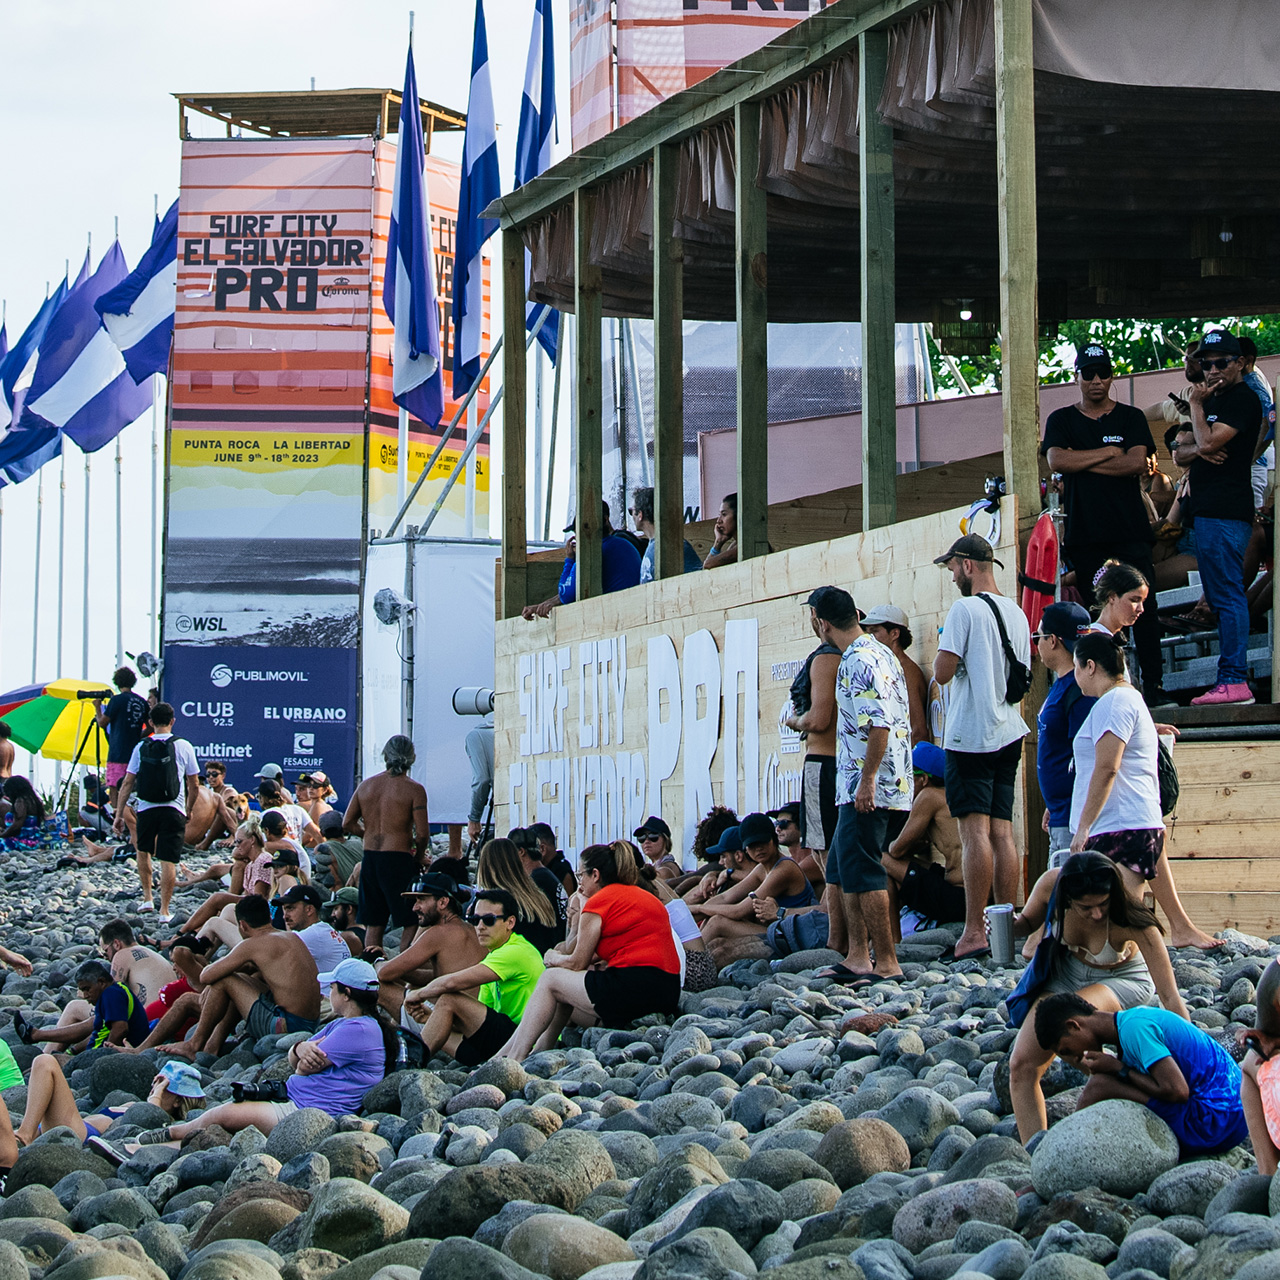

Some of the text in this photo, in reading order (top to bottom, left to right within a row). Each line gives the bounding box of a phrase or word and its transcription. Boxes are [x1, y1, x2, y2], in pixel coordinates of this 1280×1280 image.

[210, 215, 337, 238] SURF CITY
[184, 239, 218, 266] EL
[214, 267, 319, 311] PRO
[321, 285, 360, 298] Corona
[184, 440, 351, 450] PUNTA ROCA LA LIBERTAD
[214, 453, 243, 463] JUNE
[248, 453, 262, 463] 9th
[271, 453, 290, 463] 18th
[292, 453, 319, 463] 2023
[193, 617, 227, 631] WSL
[234, 671, 309, 682] PUBLIMOVIL
[519, 634, 627, 756] SURF CITY
[181, 701, 234, 717] CLUB
[263, 707, 347, 720] EL URBANO
[213, 718, 234, 727] 92.5
[283, 757, 323, 767] FESASURF
